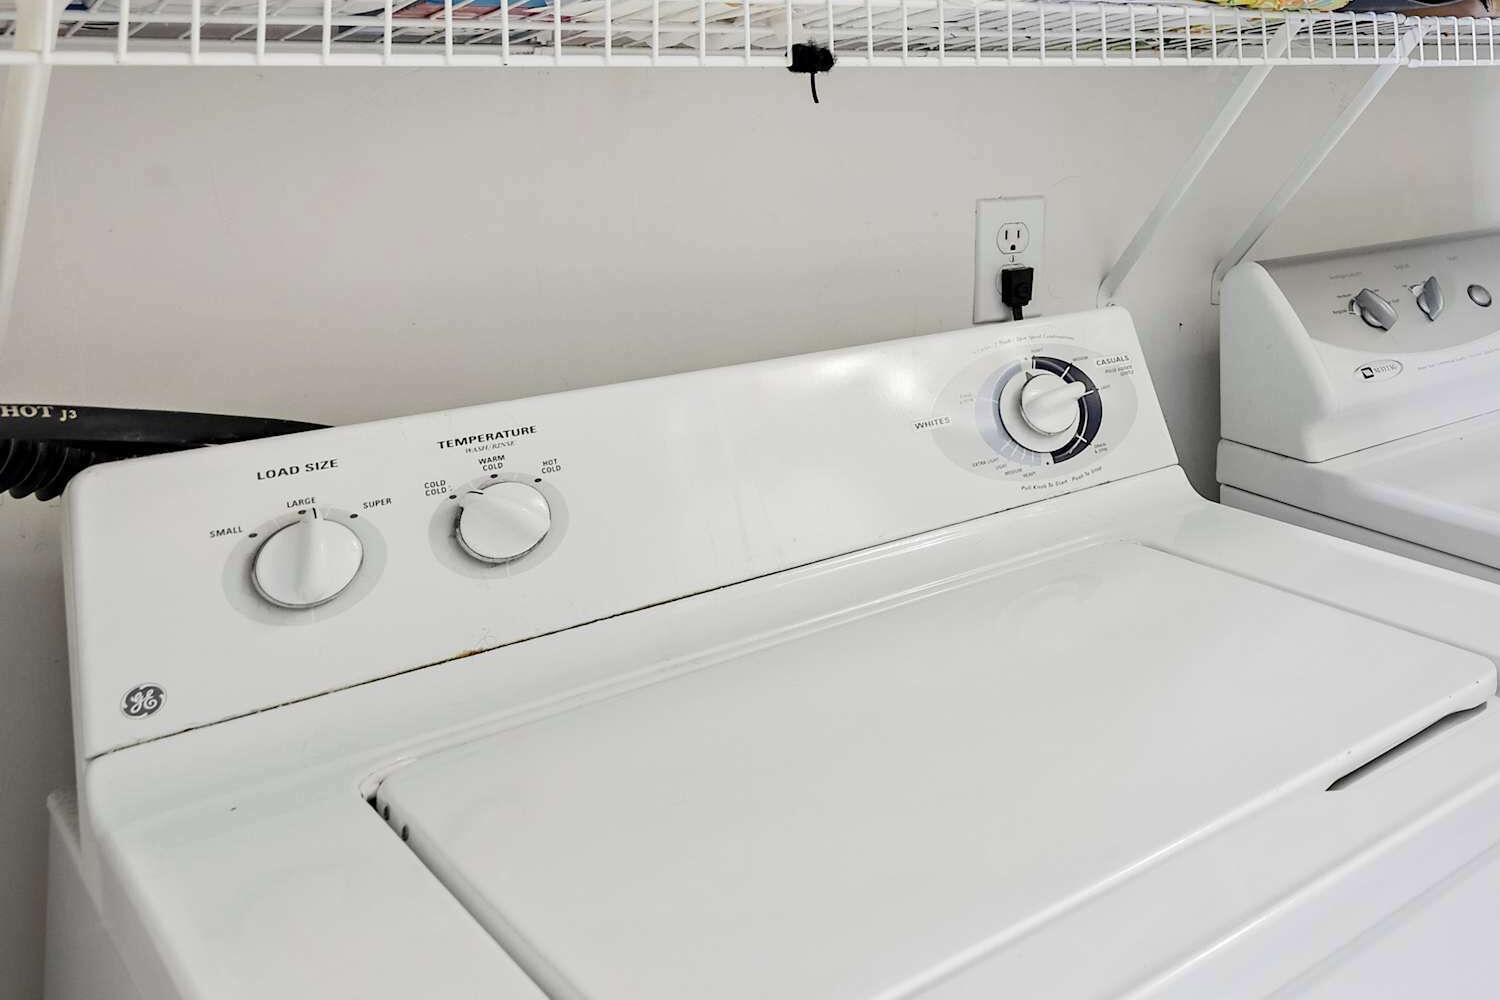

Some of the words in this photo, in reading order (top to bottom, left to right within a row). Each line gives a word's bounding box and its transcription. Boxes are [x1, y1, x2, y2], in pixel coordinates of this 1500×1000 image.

[1096, 355, 1130, 367] CASUALS
[0, 405, 54, 418] HOT
[914, 416, 951, 430] WHITES
[437, 425, 538, 449] TEMPERATURE
[478, 454, 506, 465] WARM
[542, 458, 558, 466] HOT
[256, 464, 300, 481] LOAD
[305, 459, 339, 473] SIZE
[482, 462, 504, 472] COLD
[541, 465, 561, 474] COLD
[424, 479, 446, 489] COLD
[425, 486, 447, 497] COLD
[286, 497, 316, 509] LARGE
[362, 497, 393, 510] SUPER
[209, 525, 243, 539] SMALL
